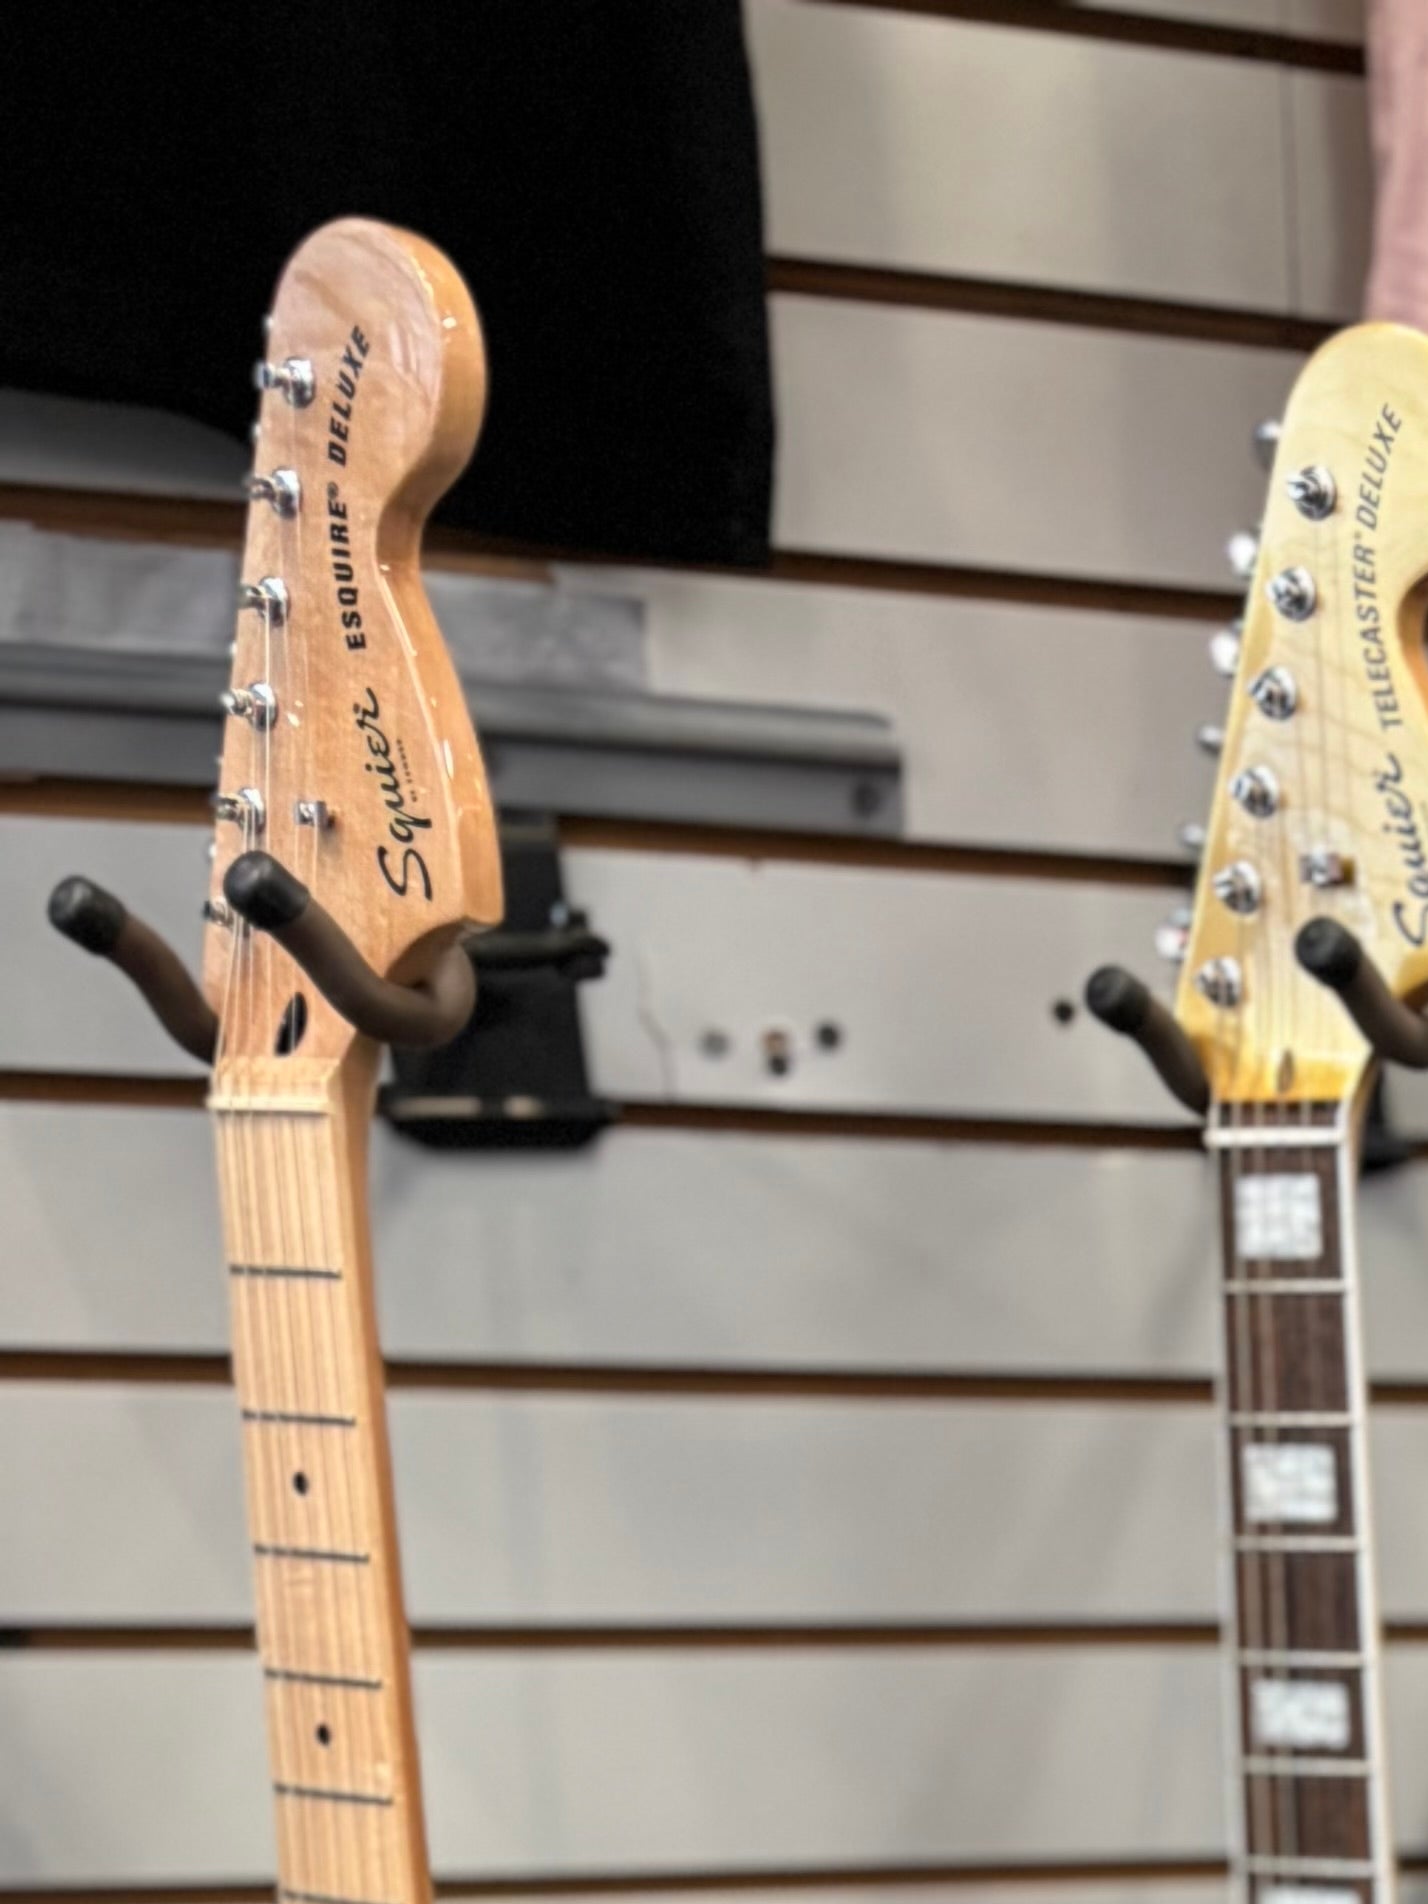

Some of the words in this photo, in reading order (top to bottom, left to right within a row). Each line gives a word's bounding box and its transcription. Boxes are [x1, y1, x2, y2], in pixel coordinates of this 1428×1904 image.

[327, 325, 371, 468] DELUXE
[1356, 402, 1402, 531] DELUXE
[353, 686, 432, 902] Squier
